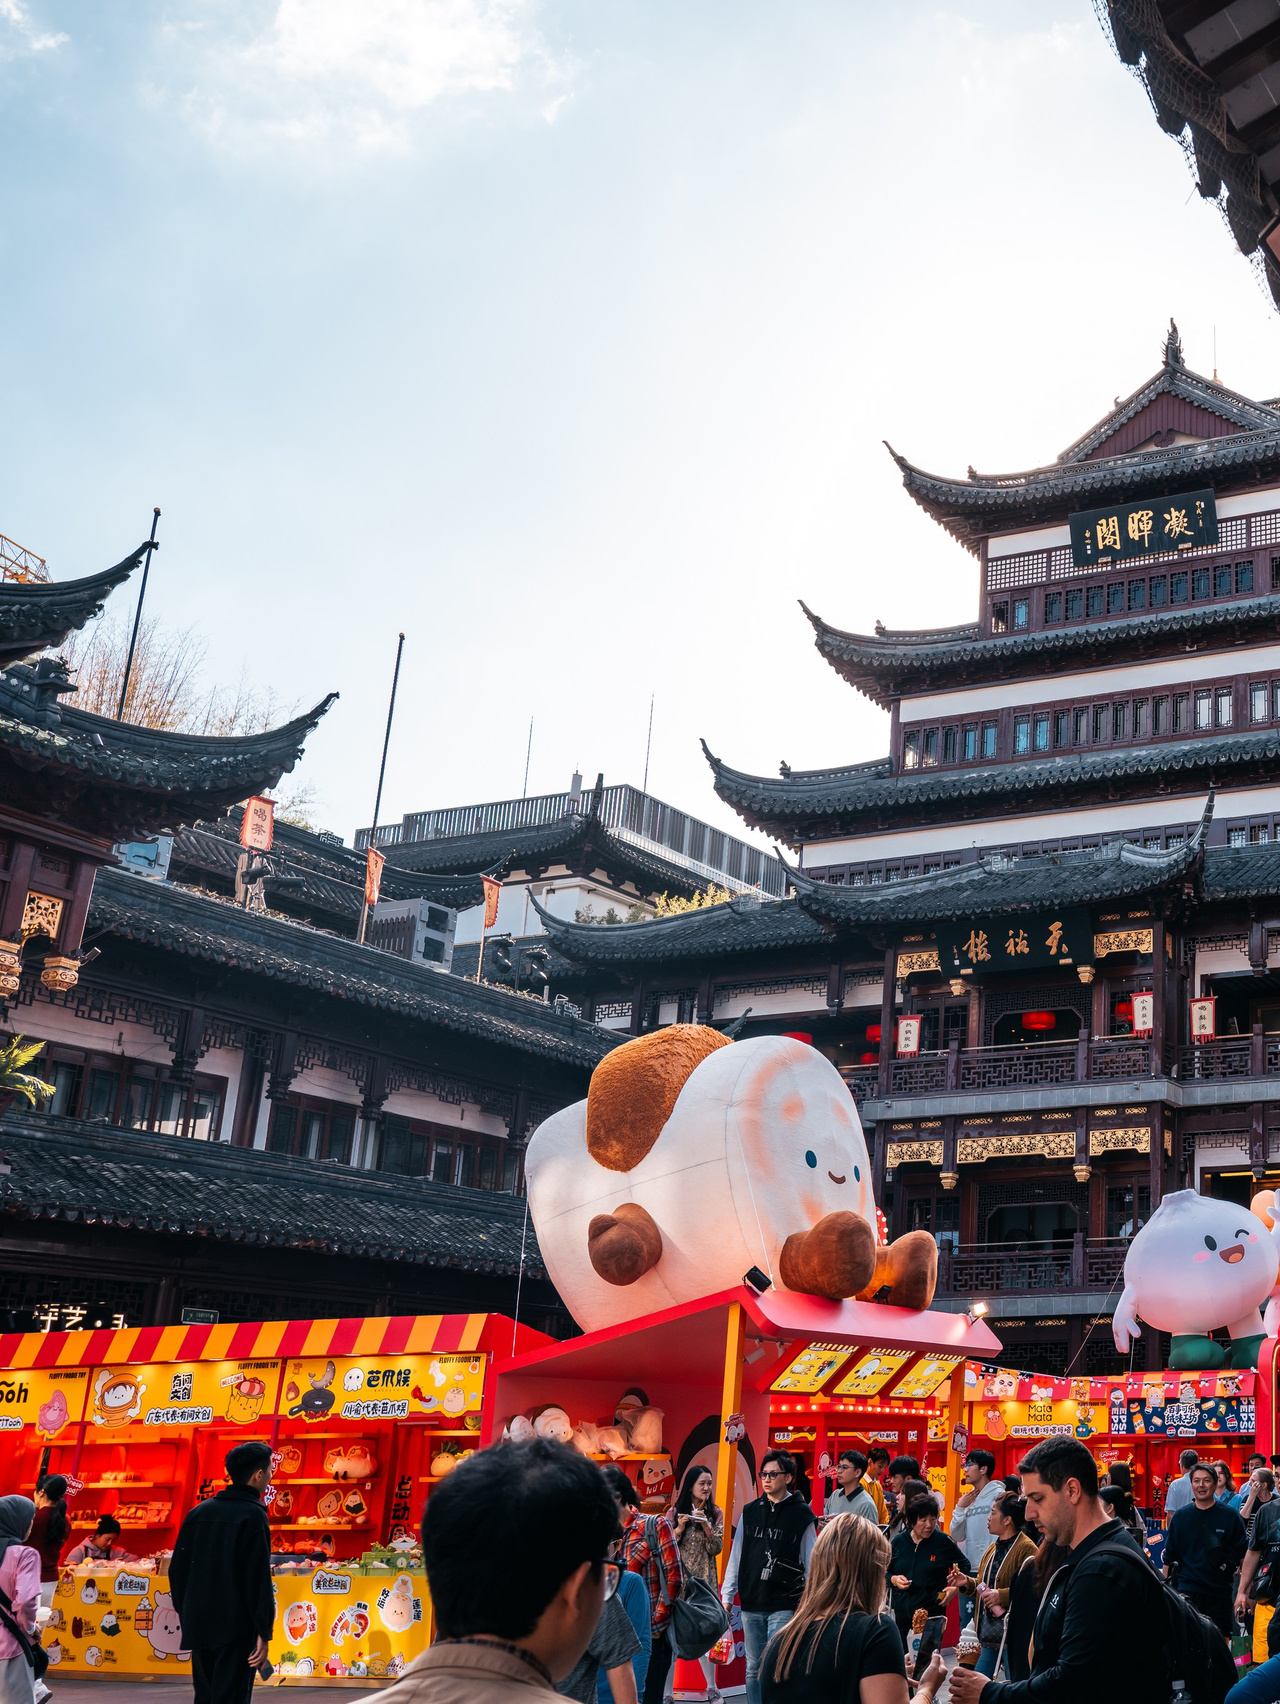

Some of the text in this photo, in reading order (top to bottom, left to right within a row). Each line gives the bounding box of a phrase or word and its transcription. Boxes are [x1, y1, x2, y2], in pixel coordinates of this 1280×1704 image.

[251, 808, 267, 836] 喝茶
[222, 1374, 243, 1386] WELCOME
[1028, 1404, 1052, 1413] Mata
[1169, 1404, 1195, 1413] 百事可乐
[1028, 1413, 1052, 1421] Mata
[1111, 1408, 1119, 1434] EPSI
[1153, 1487, 1163, 1517] 美食
